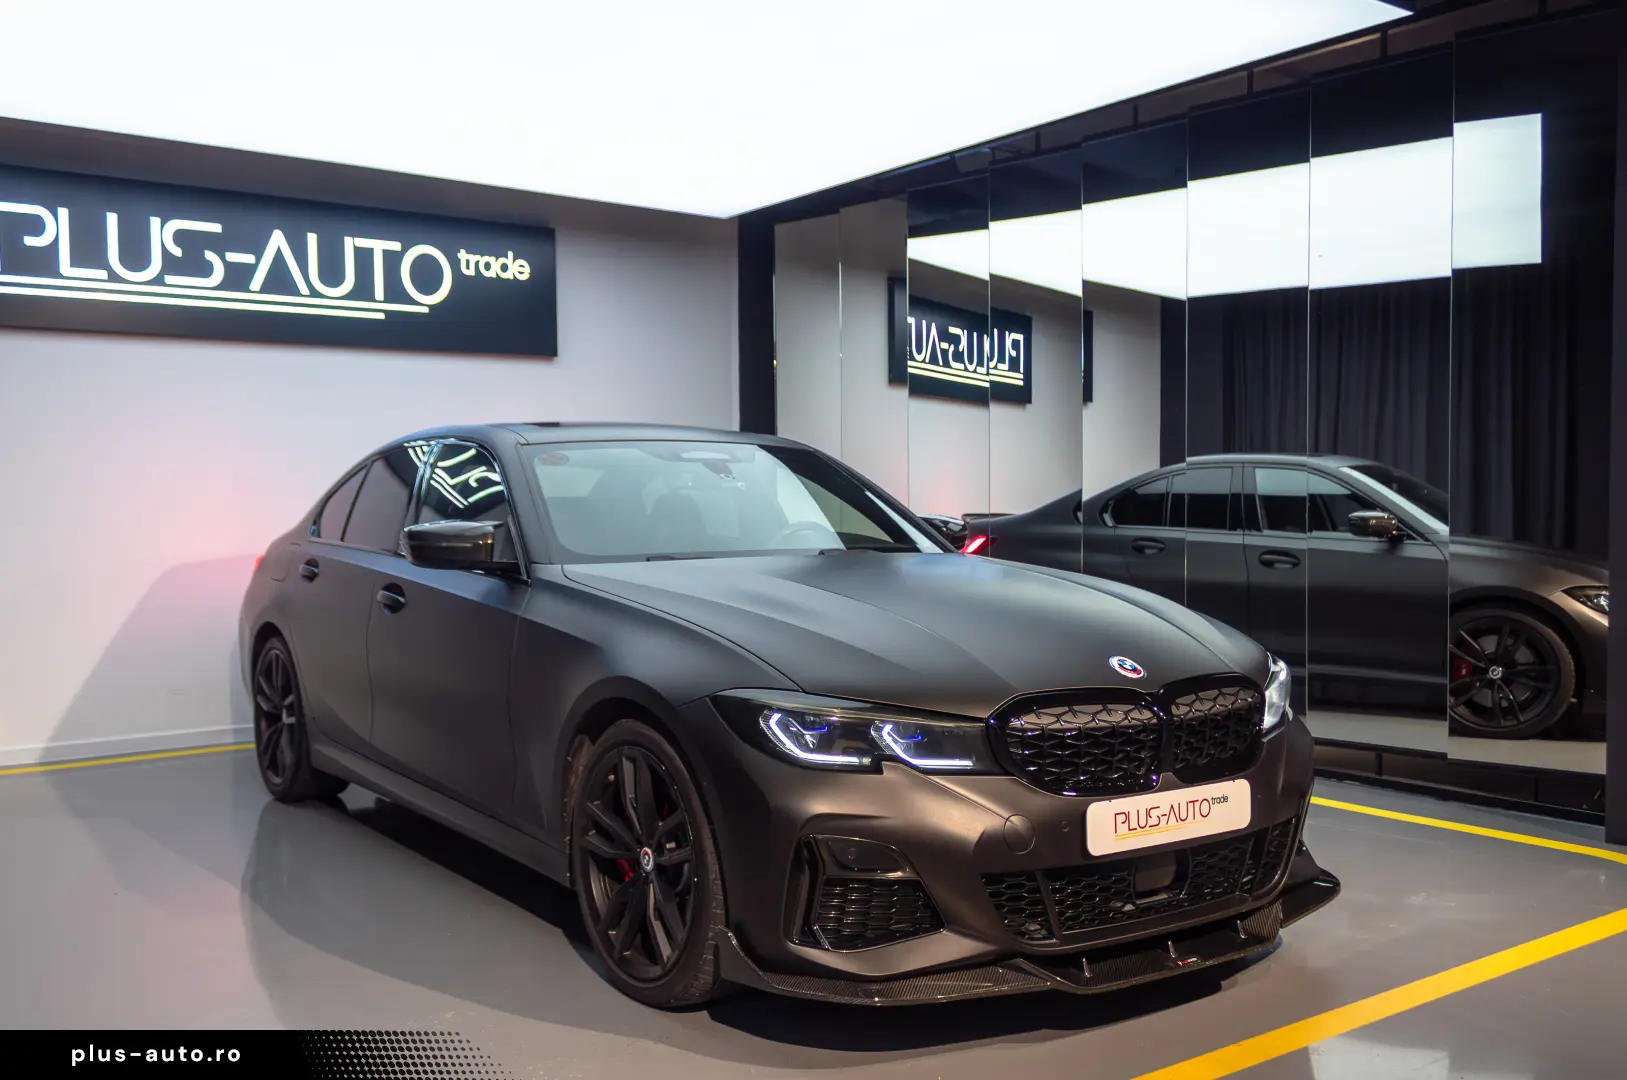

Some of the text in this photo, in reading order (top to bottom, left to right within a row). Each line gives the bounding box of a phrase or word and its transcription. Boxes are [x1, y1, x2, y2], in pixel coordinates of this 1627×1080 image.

[0, 201, 531, 305] PLUS-AUTO trade
[1114, 795, 1229, 834] PLUS-AUTO trade
